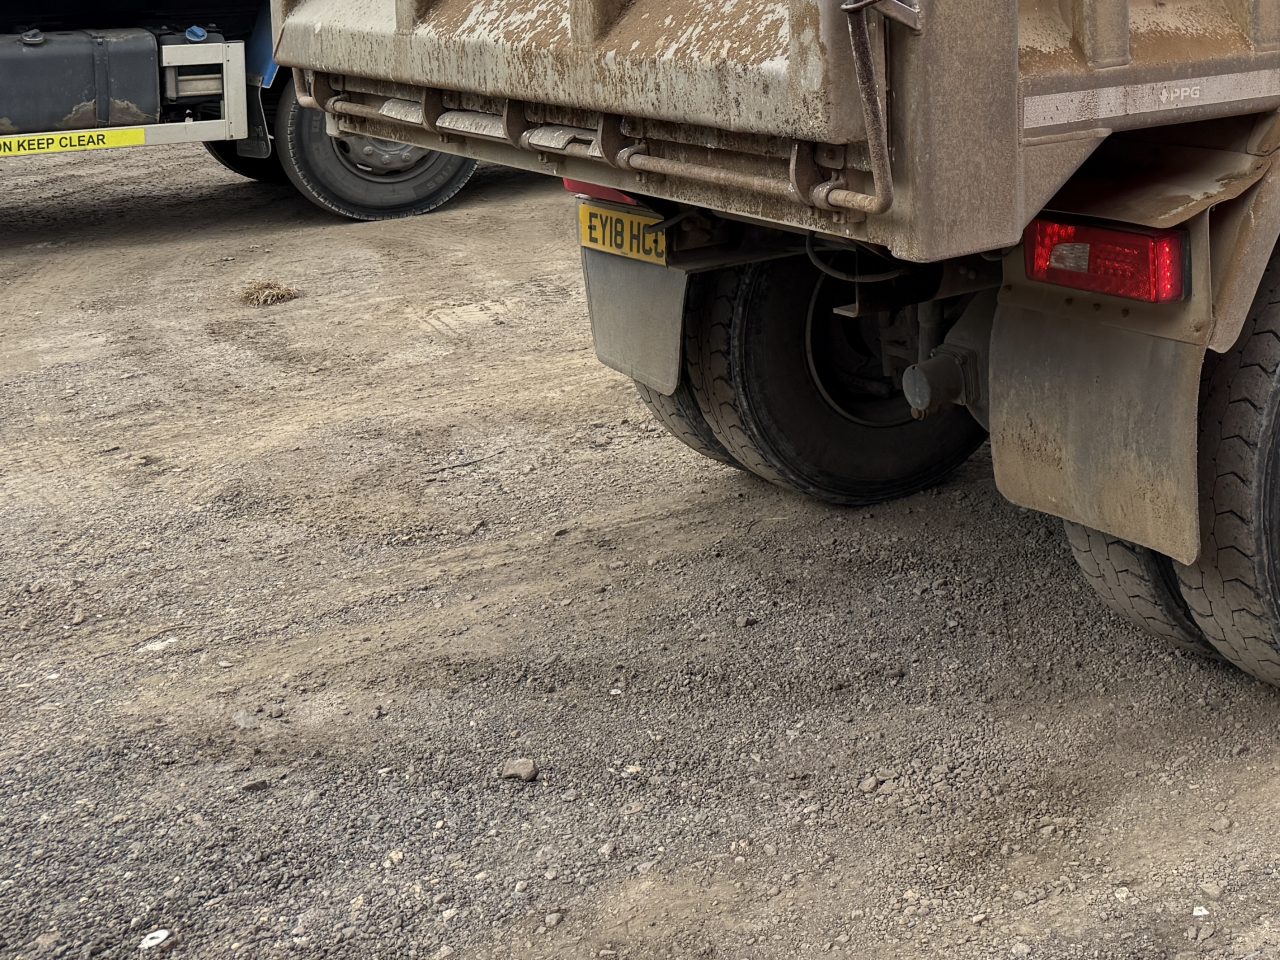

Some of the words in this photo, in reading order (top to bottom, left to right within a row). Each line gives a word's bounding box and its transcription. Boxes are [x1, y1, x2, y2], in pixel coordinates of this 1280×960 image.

[1170, 86, 1201, 100] PPG
[17, 137, 55, 151] KEEP
[59, 133, 106, 149] CLEAR
[587, 211, 625, 250] EY18
